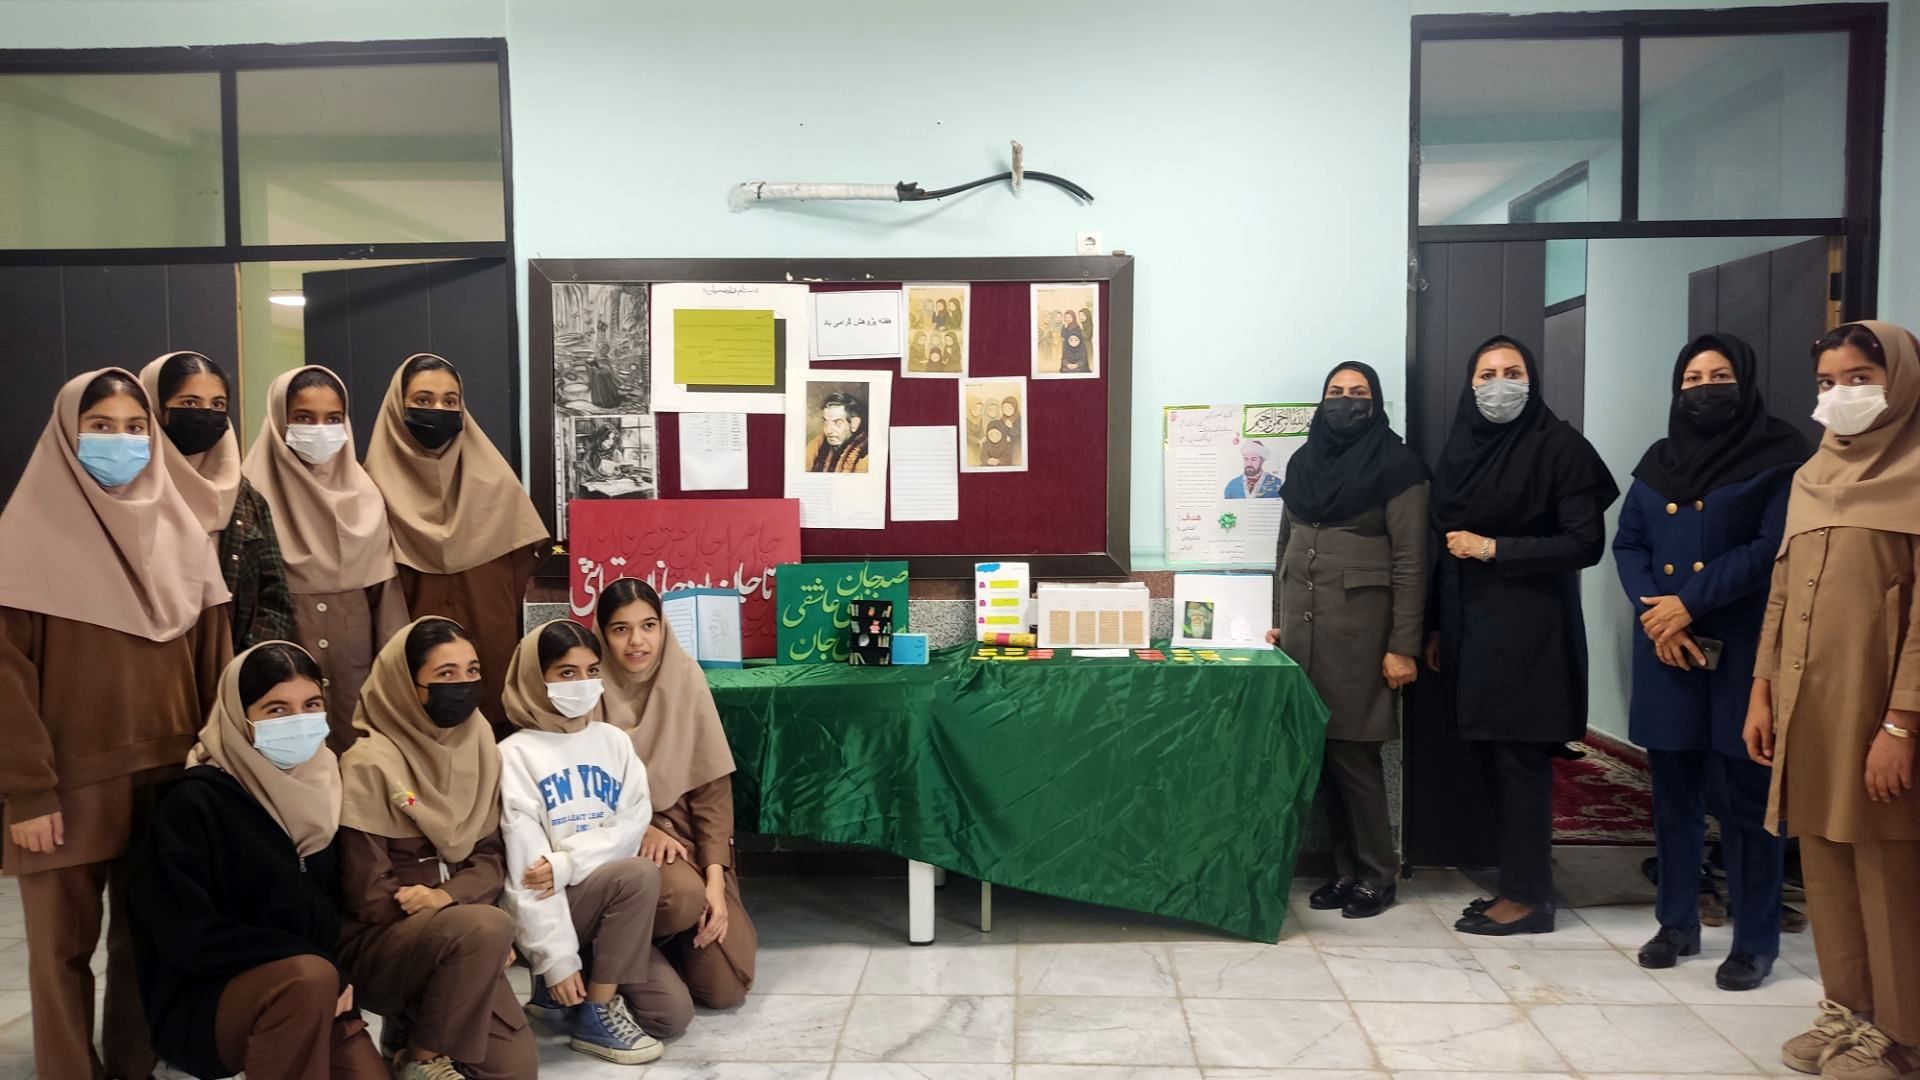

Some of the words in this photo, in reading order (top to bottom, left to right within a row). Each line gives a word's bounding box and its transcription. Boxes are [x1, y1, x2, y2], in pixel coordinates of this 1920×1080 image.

[833, 317, 852, 328] گرامی
[853, 317, 877, 327] پژوهش
[782, 577, 840, 628] عاشقی
[789, 626, 838, 662] جان
[538, 767, 574, 811] EW
